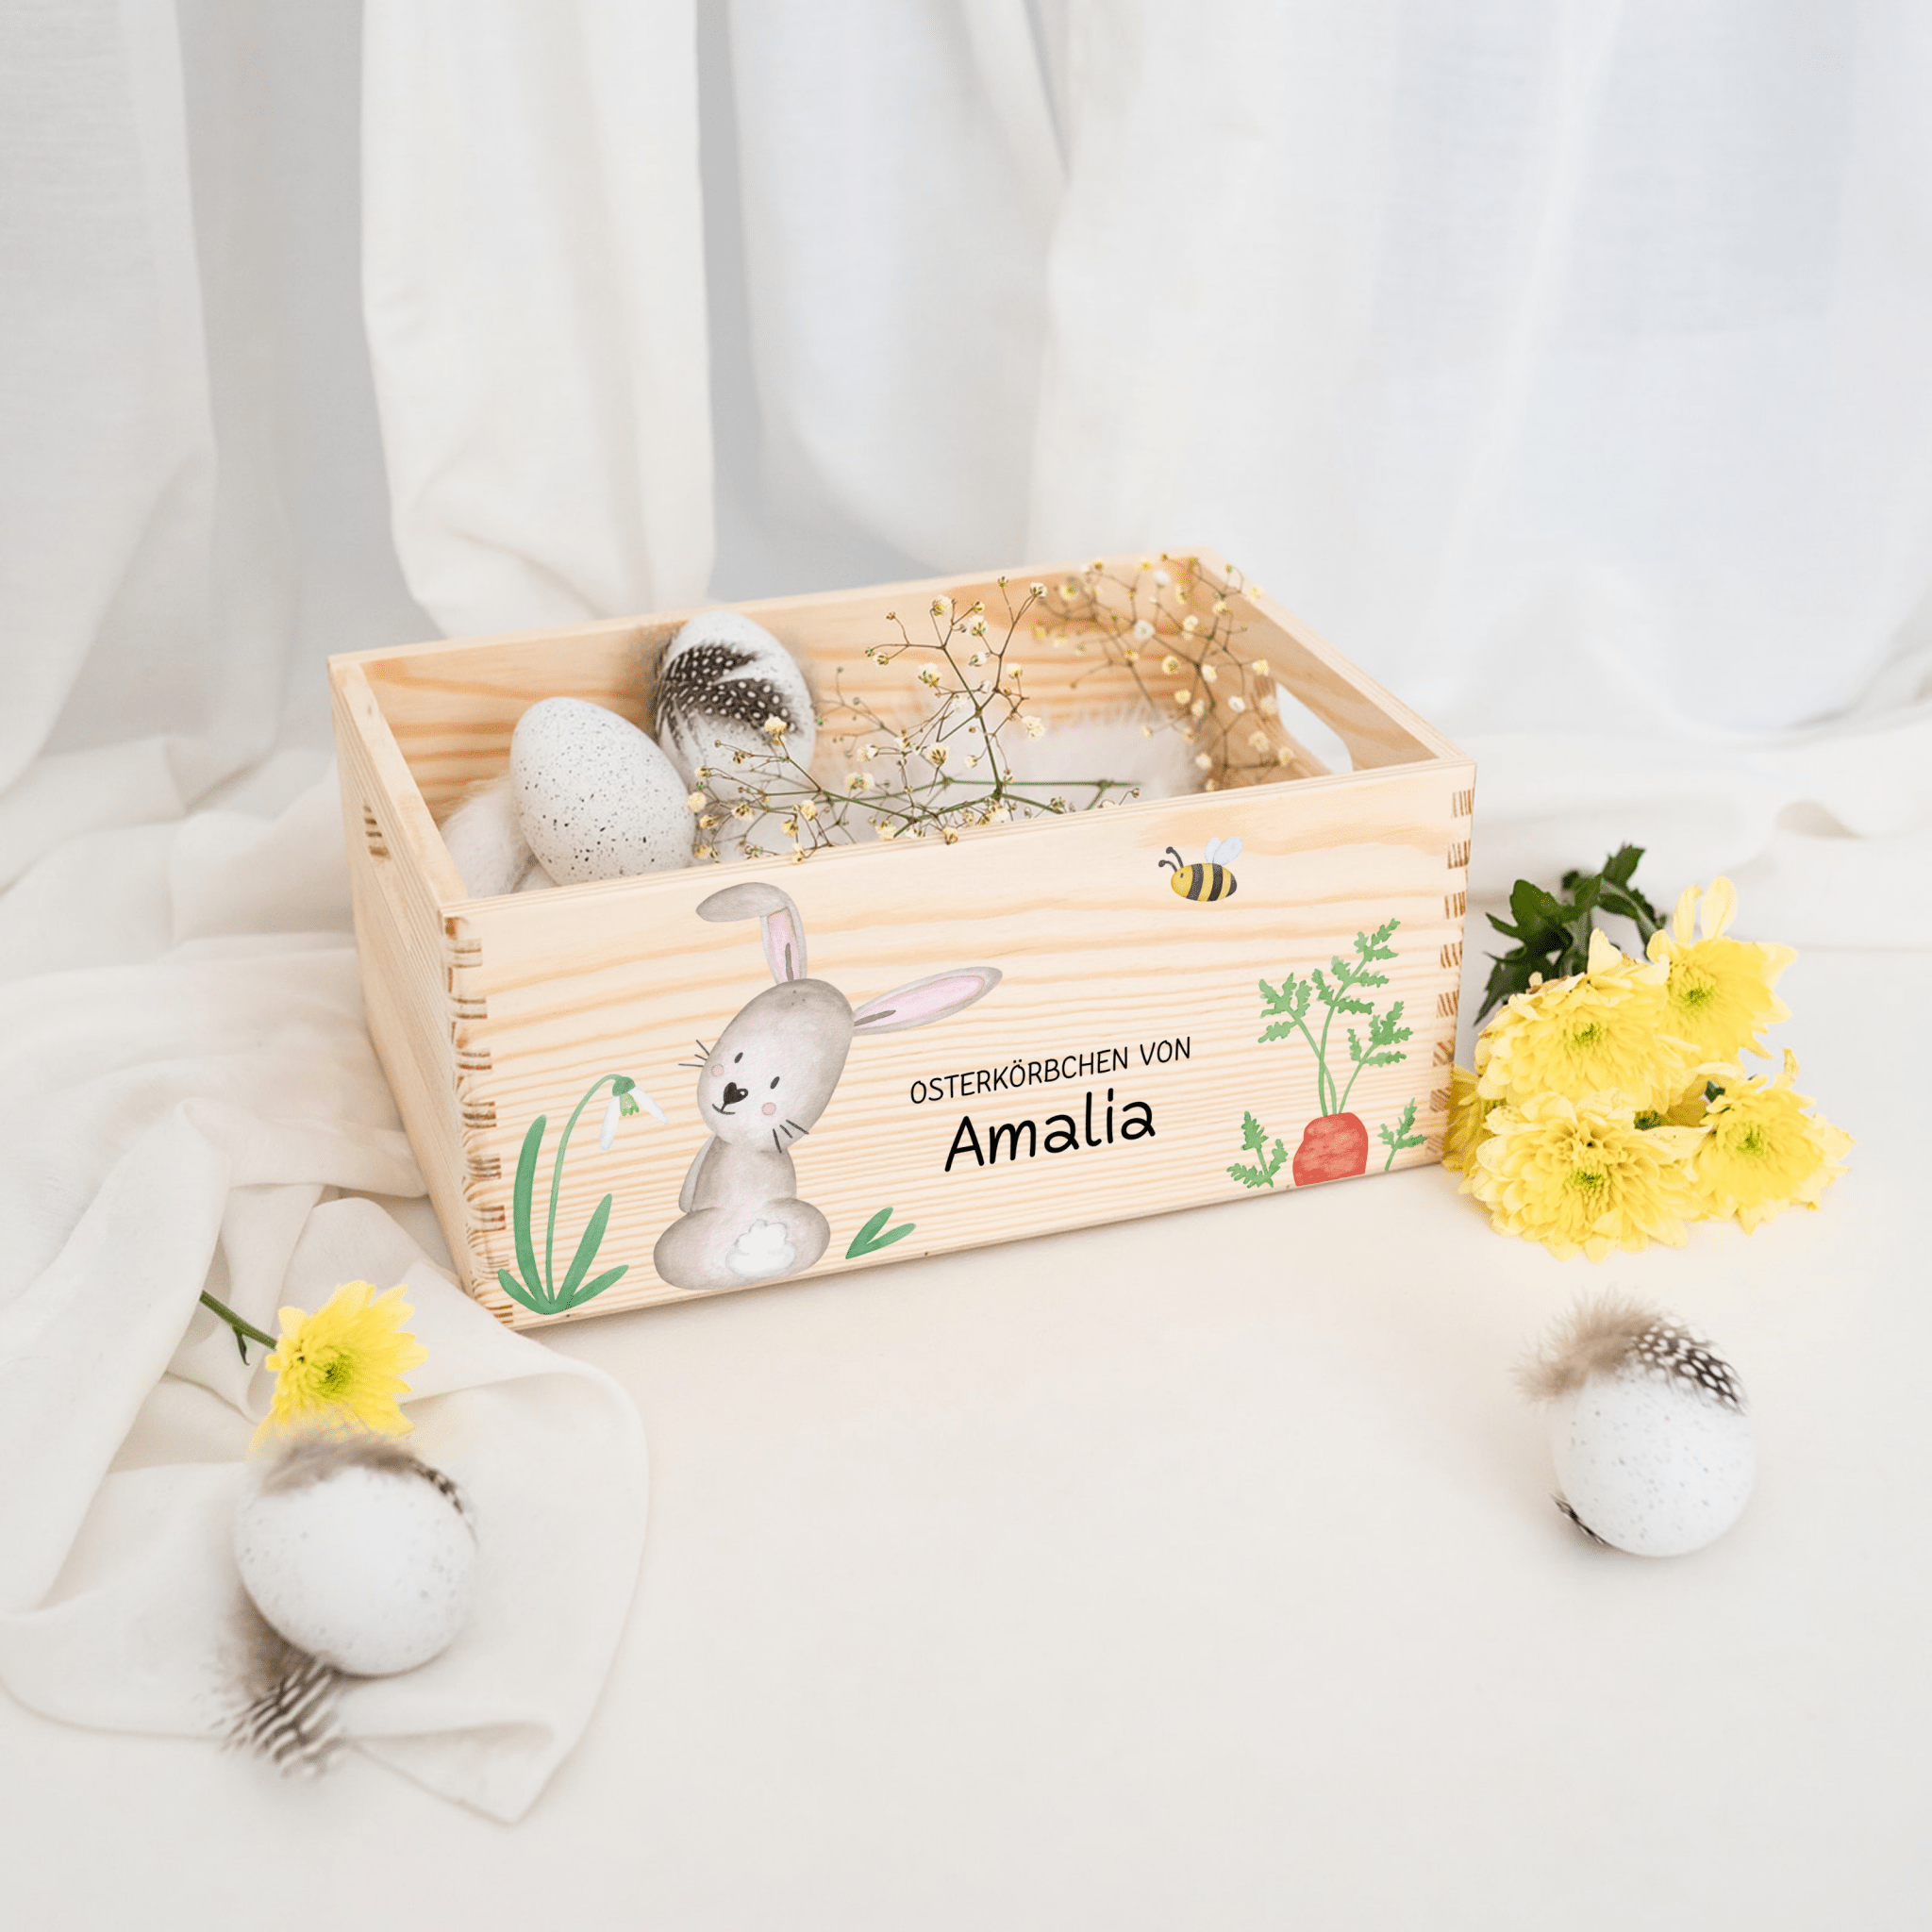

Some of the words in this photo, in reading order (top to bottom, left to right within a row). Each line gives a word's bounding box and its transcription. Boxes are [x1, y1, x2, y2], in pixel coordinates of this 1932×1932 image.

[910, 1046, 1128, 1105] OSTERKÖRBCHEN
[1140, 1036, 1191, 1066] VON
[944, 1087, 1157, 1173] Amalia
